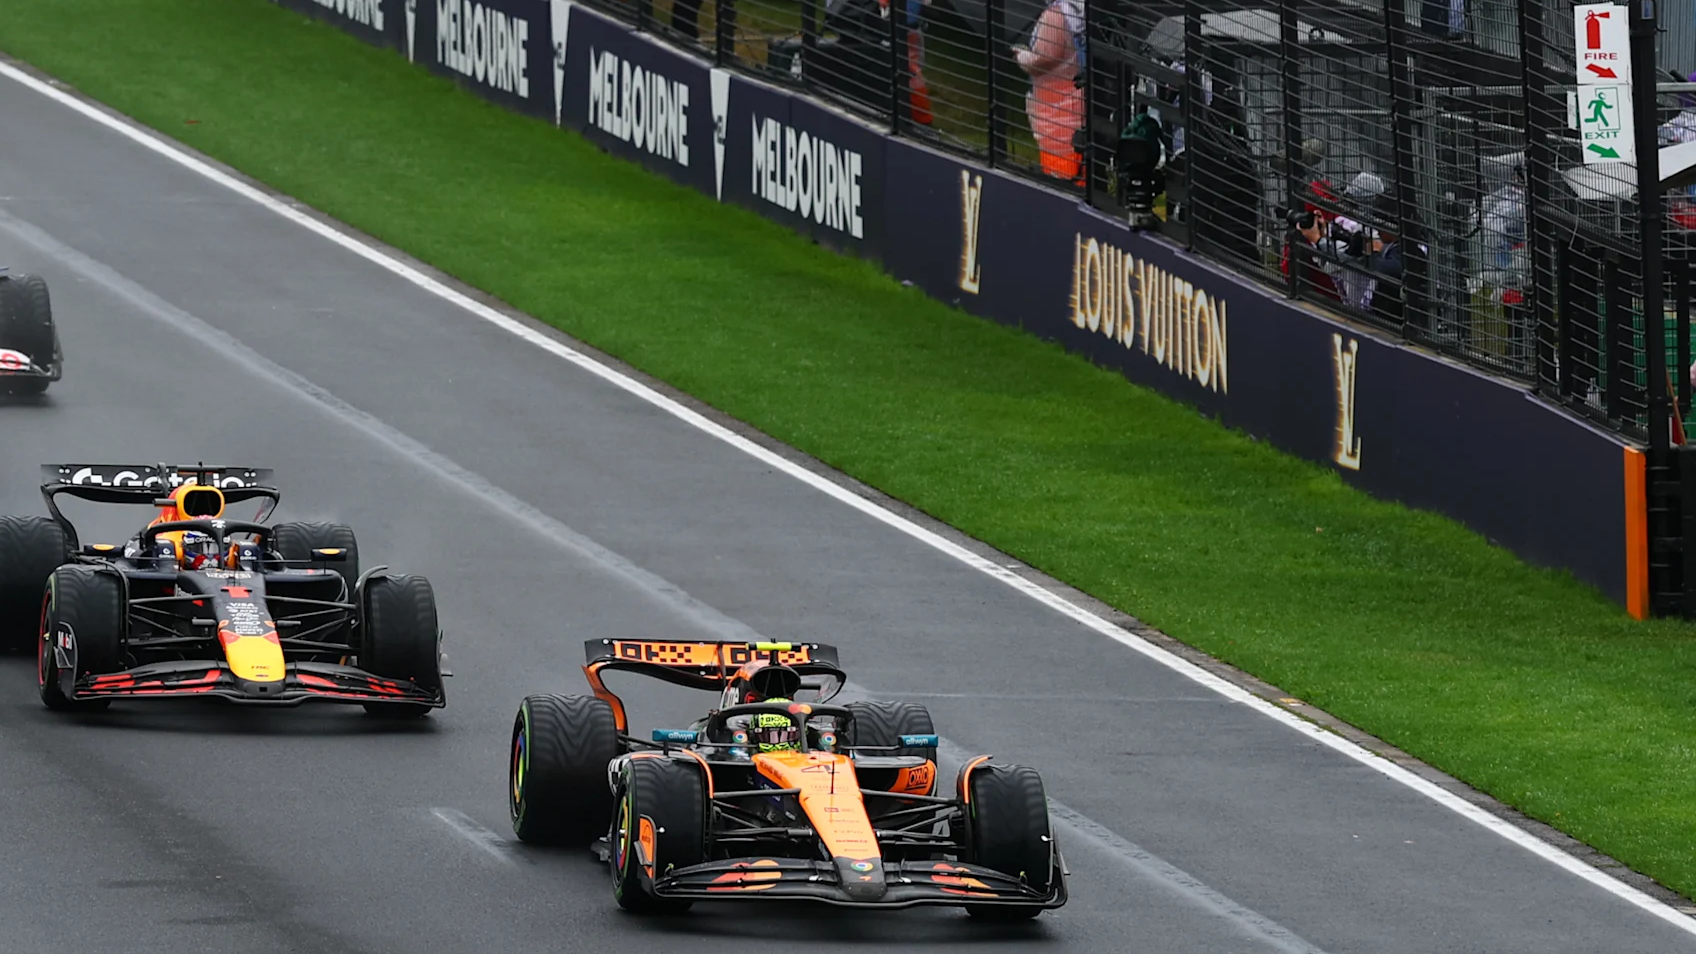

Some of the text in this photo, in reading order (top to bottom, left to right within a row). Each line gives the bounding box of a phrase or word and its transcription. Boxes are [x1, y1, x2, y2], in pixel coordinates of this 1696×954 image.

[1584, 52, 1619, 61] FIRE
[587, 46, 690, 168] MELBOURNE
[1585, 130, 1620, 140] EXIT
[751, 112, 864, 240] MELBOURNE
[1069, 231, 1229, 396] LOUIS VUITTON
[908, 767, 930, 787] OXXO
